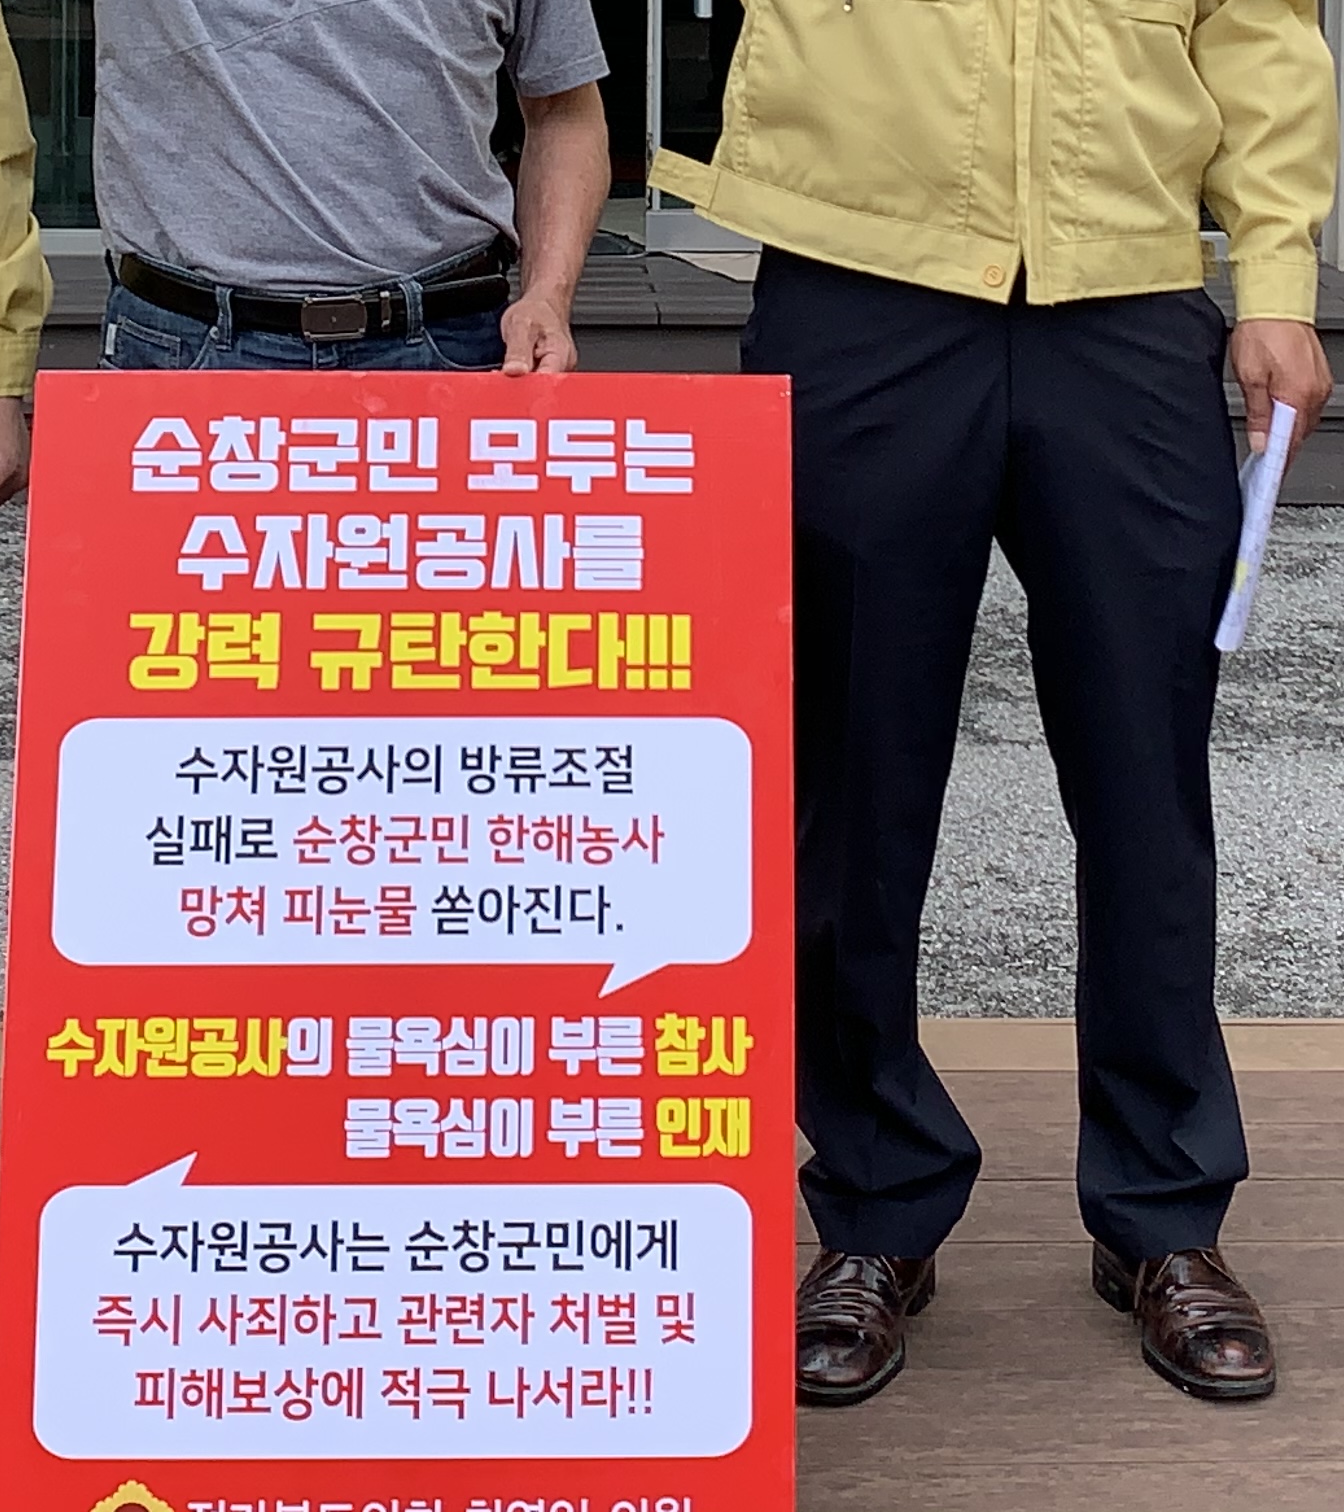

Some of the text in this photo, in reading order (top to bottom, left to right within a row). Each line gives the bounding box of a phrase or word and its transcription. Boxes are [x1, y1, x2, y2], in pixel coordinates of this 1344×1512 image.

[132, 416, 694, 493] 순창군민 모두는
[178, 514, 643, 590] 수자원공사를
[130, 611, 690, 689] 강력 규탄한다!!!
[176, 745, 632, 794] 수자원공사의 방류조절
[147, 815, 664, 865] 실패로 순창군민 한해농사
[182, 885, 622, 936] 망쳐 피눈물 쏟아진다.
[47, 1013, 753, 1076] 수자원공사의 물욕심이 부른 참사
[344, 1096, 750, 1159] 물욕심이 부른 인재
[114, 1220, 676, 1273] 수자원공사는 순창군민에게
[93, 1293, 694, 1346] 즉시 사죄하고 관련자 처벌 및
[135, 1367, 651, 1420] 피해보상에 적극 나서라!!
